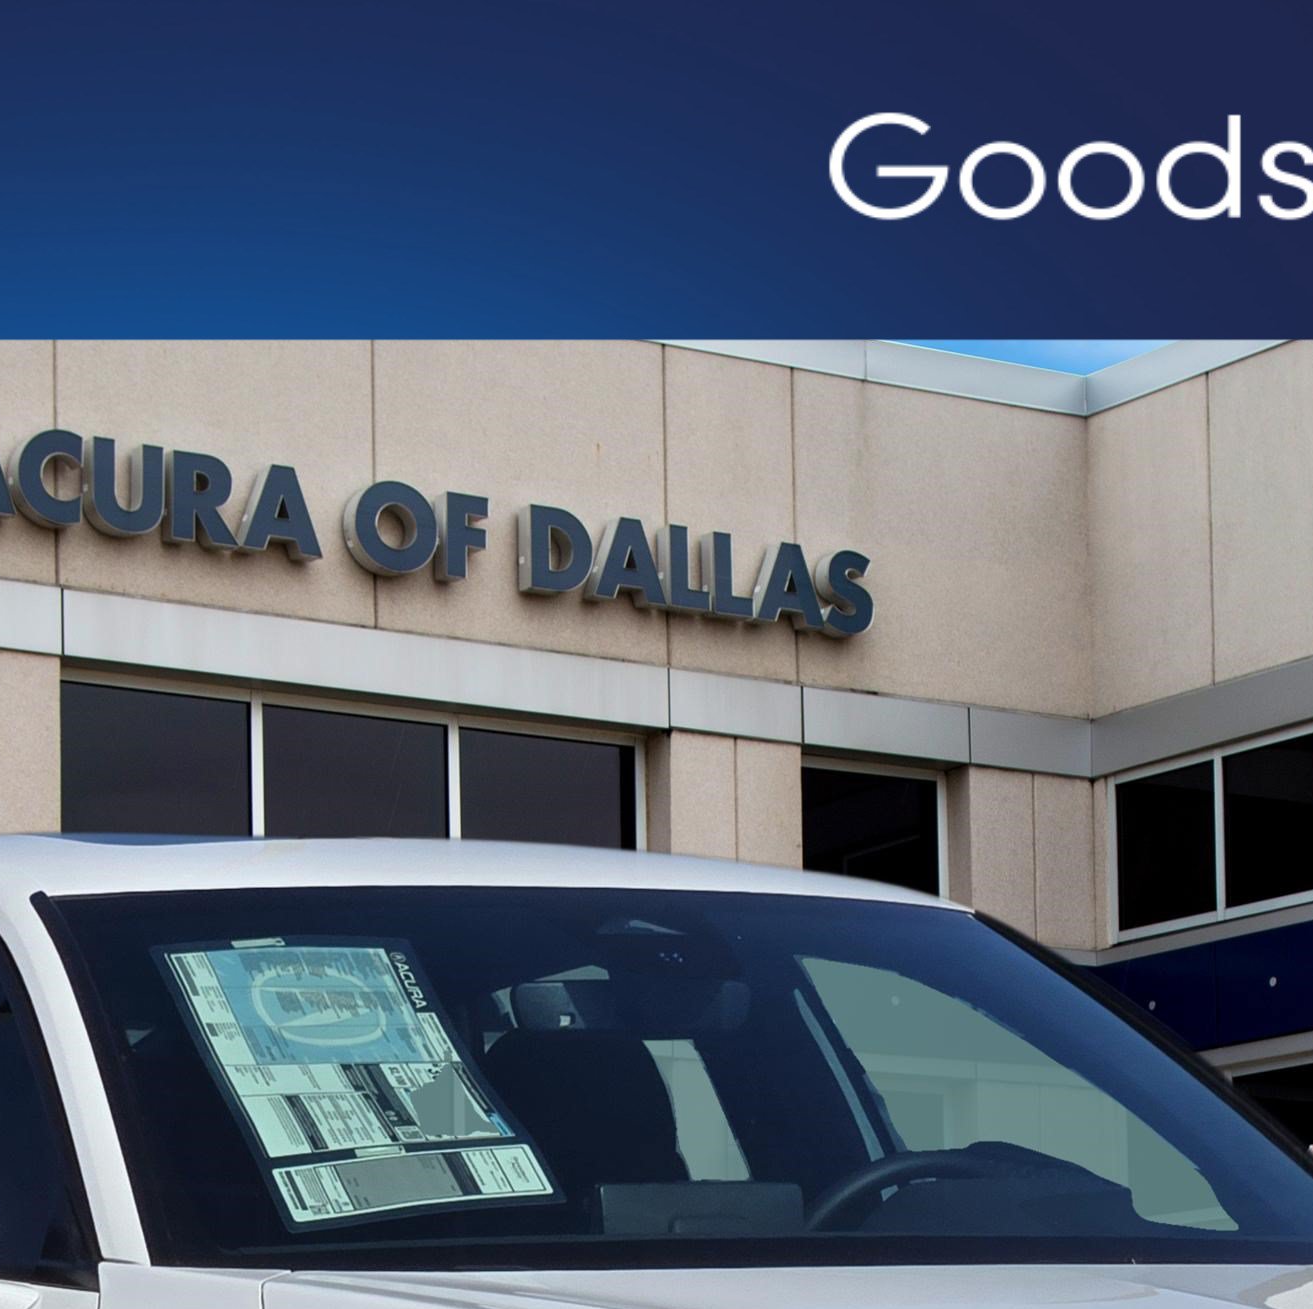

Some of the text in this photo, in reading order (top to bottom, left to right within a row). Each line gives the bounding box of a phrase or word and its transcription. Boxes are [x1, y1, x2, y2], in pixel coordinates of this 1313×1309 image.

[343, 480, 489, 583] OF
[517, 503, 875, 638] DALLAS
[394, 961, 427, 1009] ACURA
